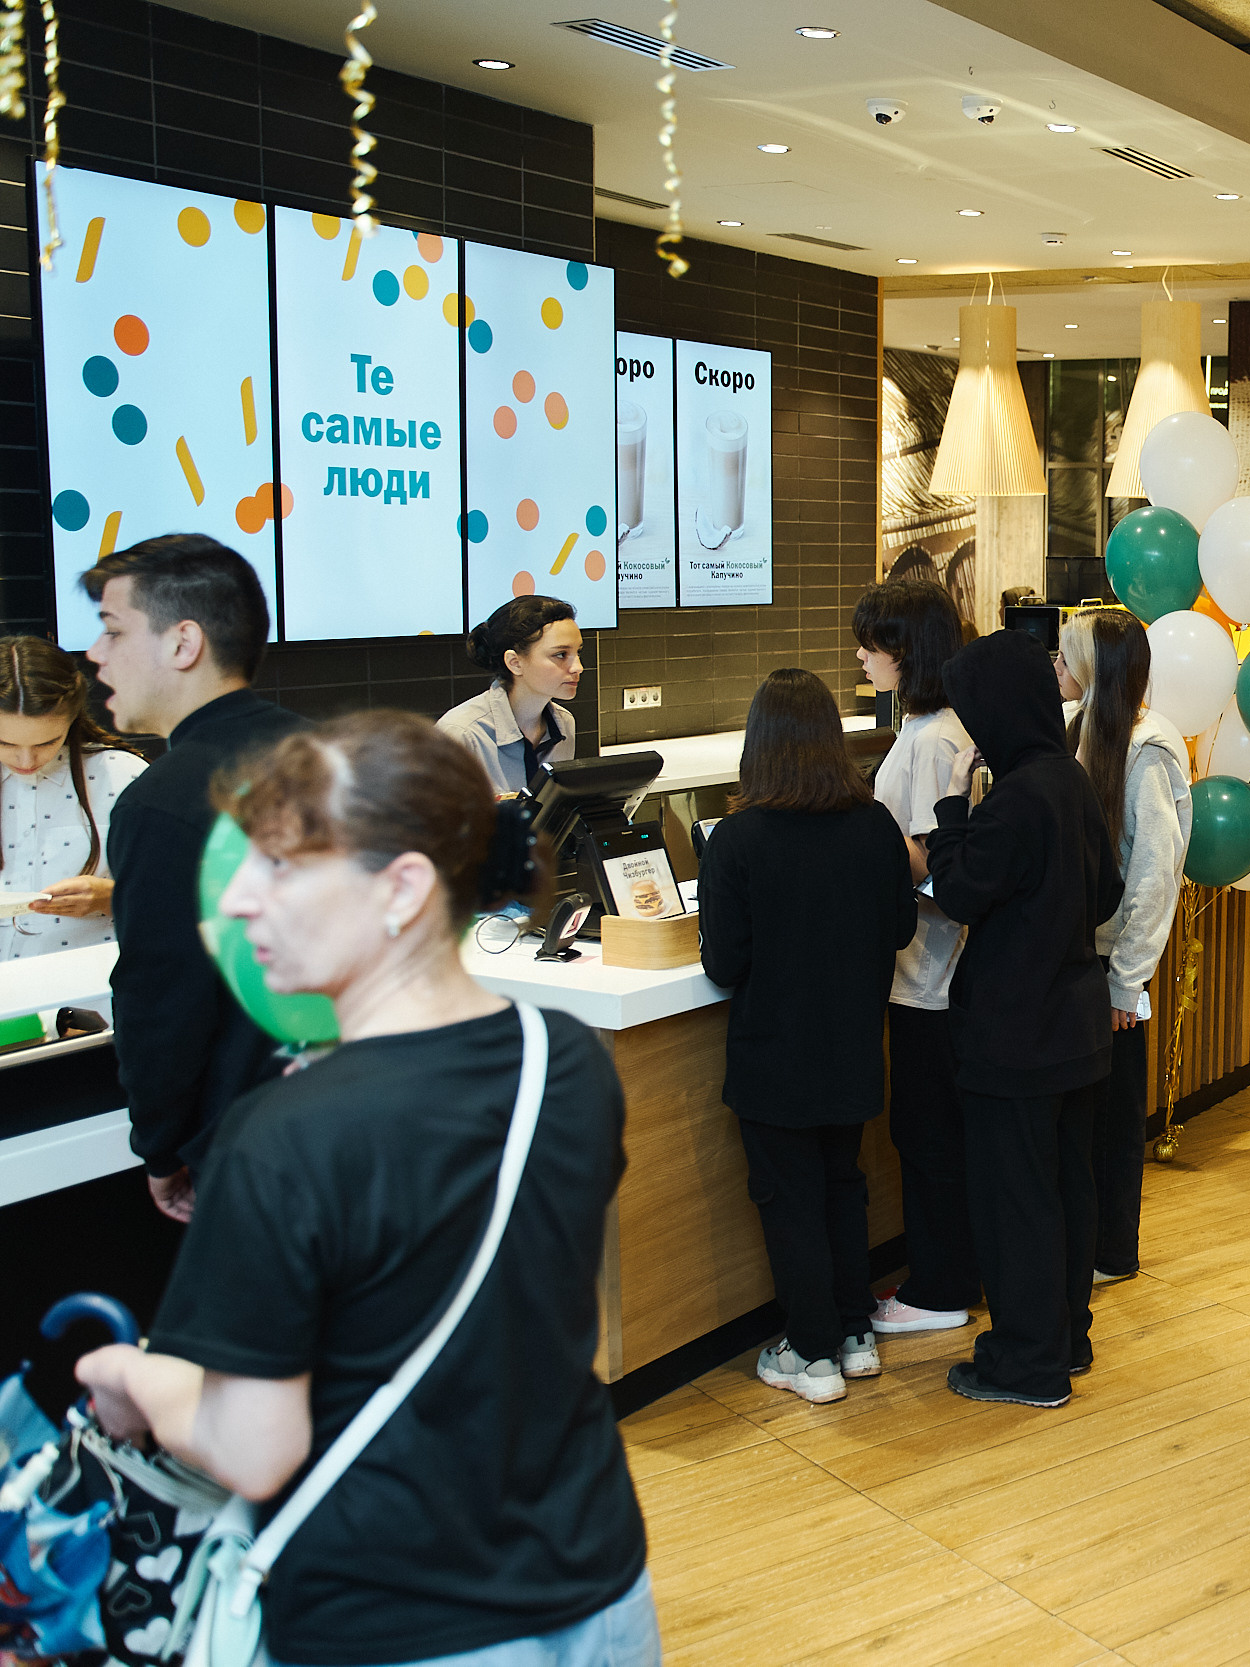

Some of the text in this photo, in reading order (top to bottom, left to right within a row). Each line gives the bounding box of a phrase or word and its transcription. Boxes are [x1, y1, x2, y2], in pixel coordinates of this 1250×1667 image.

[350, 353, 394, 396] Те
[617, 357, 655, 382] оро
[694, 361, 755, 394] Скоро
[301, 411, 442, 450] самые
[323, 466, 431, 505] люди
[623, 560, 666, 570] Кокосовый
[689, 560, 763, 569] Тот самый Кокосовый
[711, 571, 744, 580] Капучино
[622, 858, 650, 871] Двойной
[622, 867, 656, 879] Чизбургер
